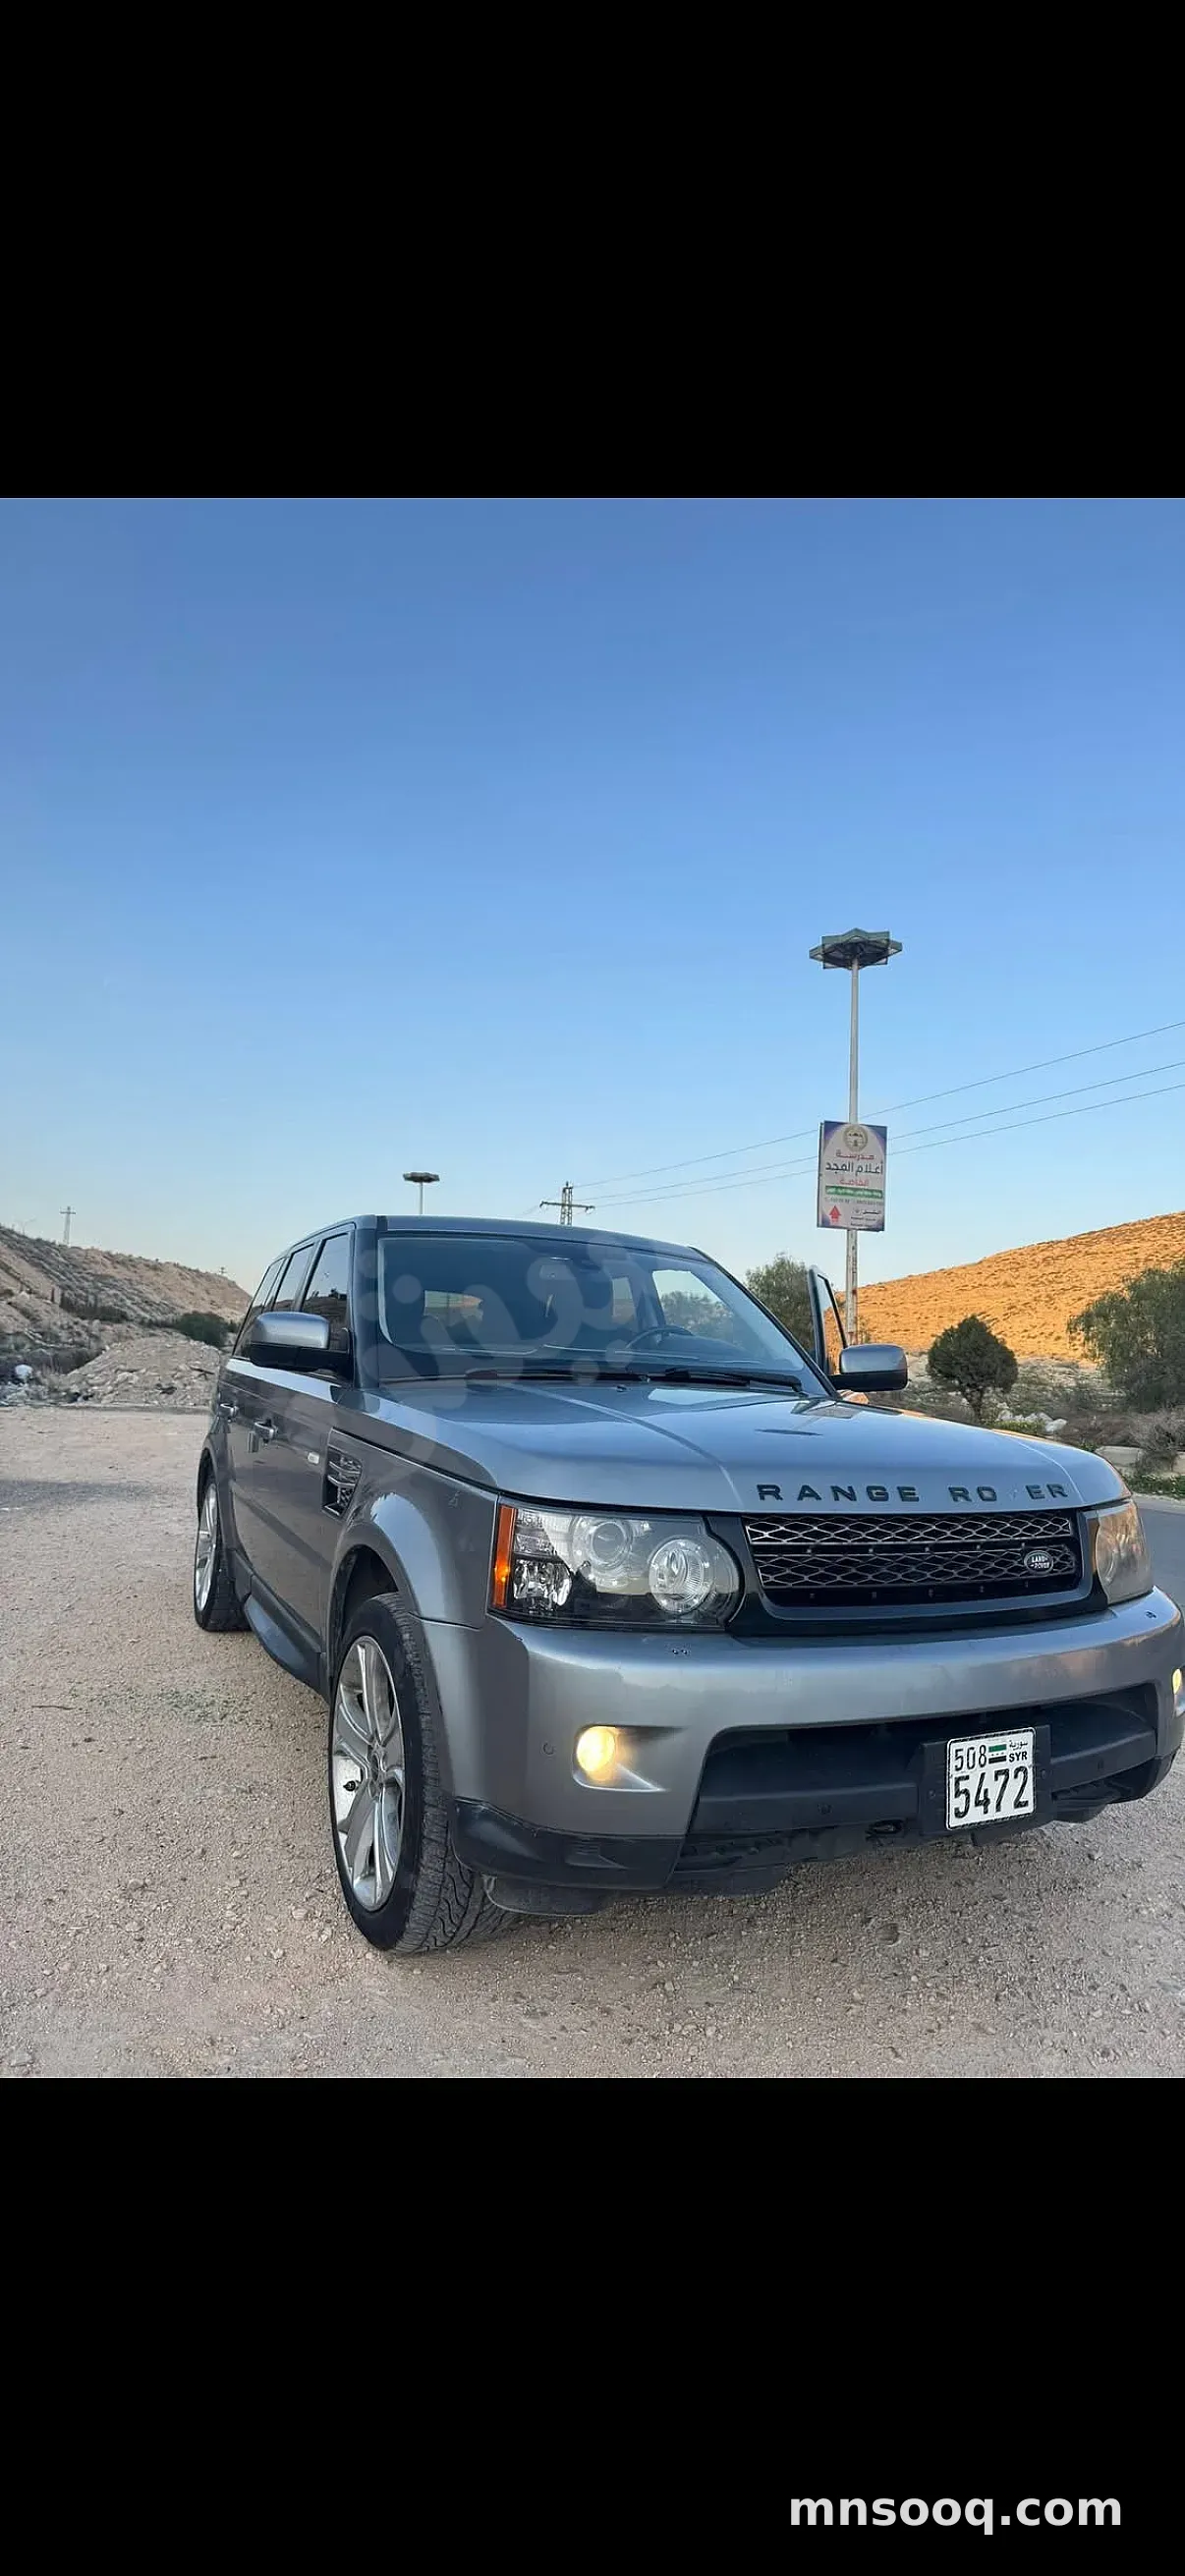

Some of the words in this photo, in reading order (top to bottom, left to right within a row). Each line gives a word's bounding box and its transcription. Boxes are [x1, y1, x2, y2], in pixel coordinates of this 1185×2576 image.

[825, 1161, 853, 1174] المجد
[856, 1159, 883, 1176] أعلام
[757, 1484, 921, 1502] RANGE
[948, 1484, 1068, 1502] ROER
[1009, 1739, 1029, 1751] سورية
[954, 1744, 988, 1771] 508
[1008, 1751, 1028, 1763] SYR
[954, 1765, 1029, 1819] 5472
